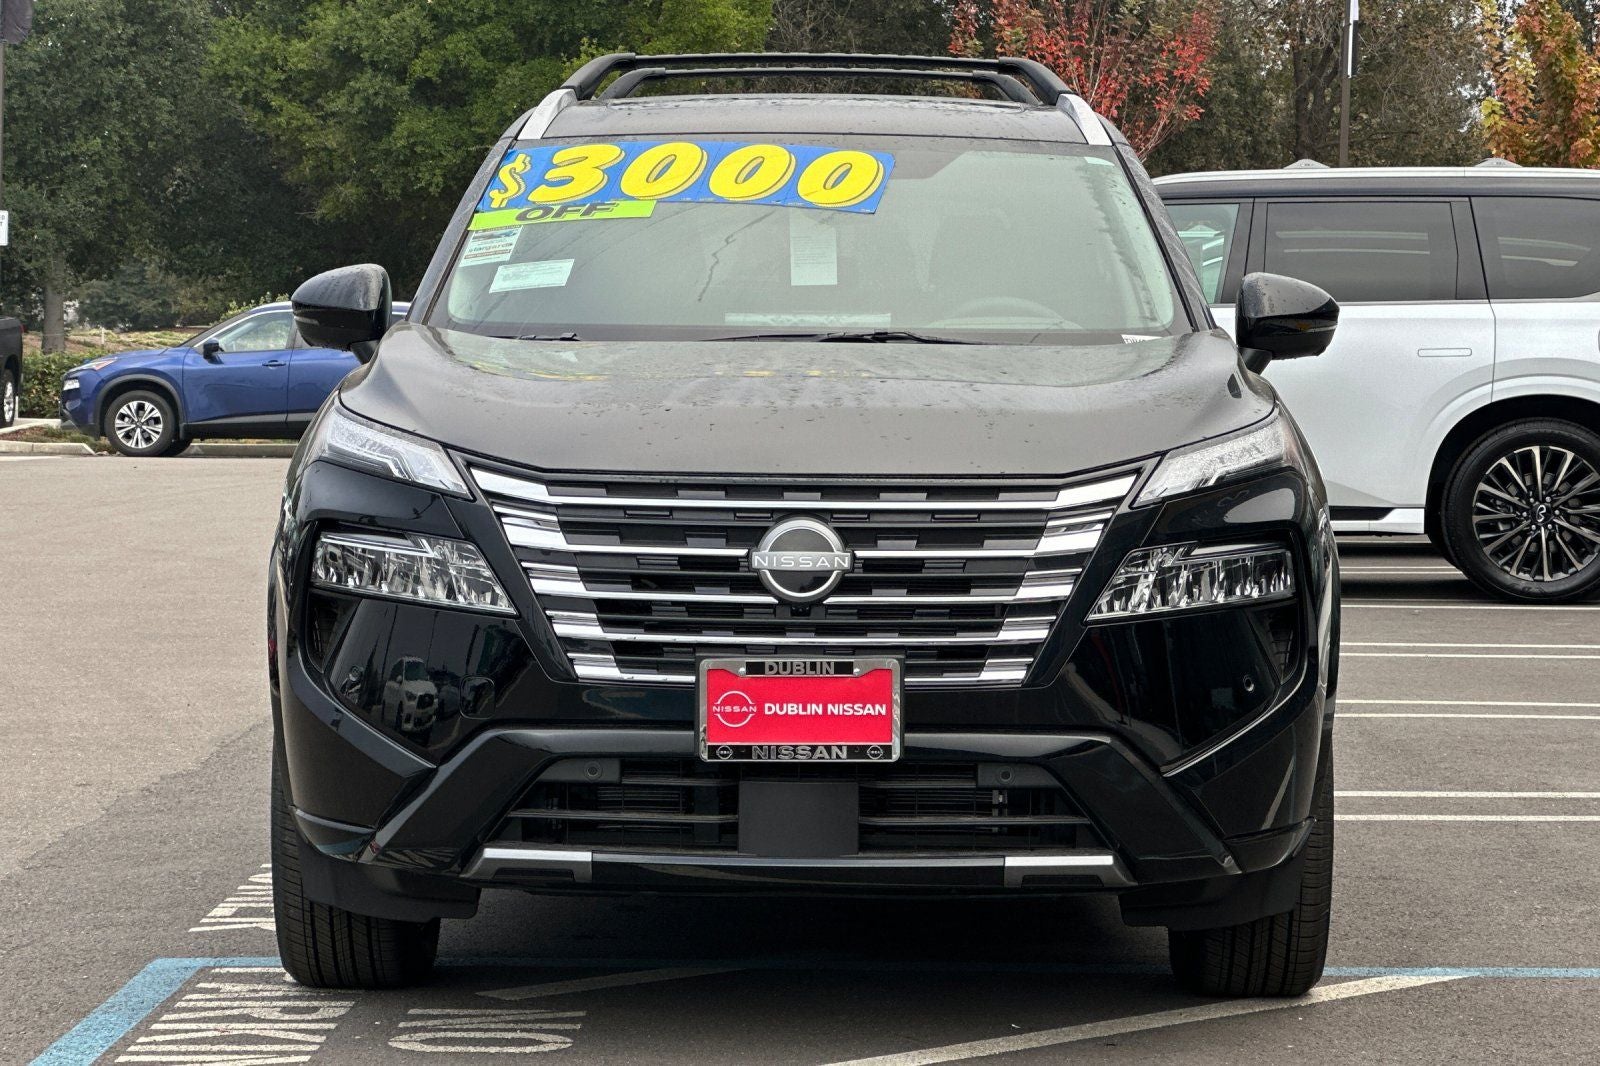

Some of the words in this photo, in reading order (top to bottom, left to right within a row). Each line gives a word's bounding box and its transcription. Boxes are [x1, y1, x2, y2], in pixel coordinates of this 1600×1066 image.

[489, 142, 886, 208] $3000
[515, 202, 621, 222] OFF
[754, 555, 849, 568] NISSAN
[764, 661, 835, 675] DUBLIN
[764, 703, 823, 716] DUBLIN
[827, 703, 887, 716] NISSAN
[752, 745, 847, 760] NISSAN
[388, 1008, 587, 1054] NO
